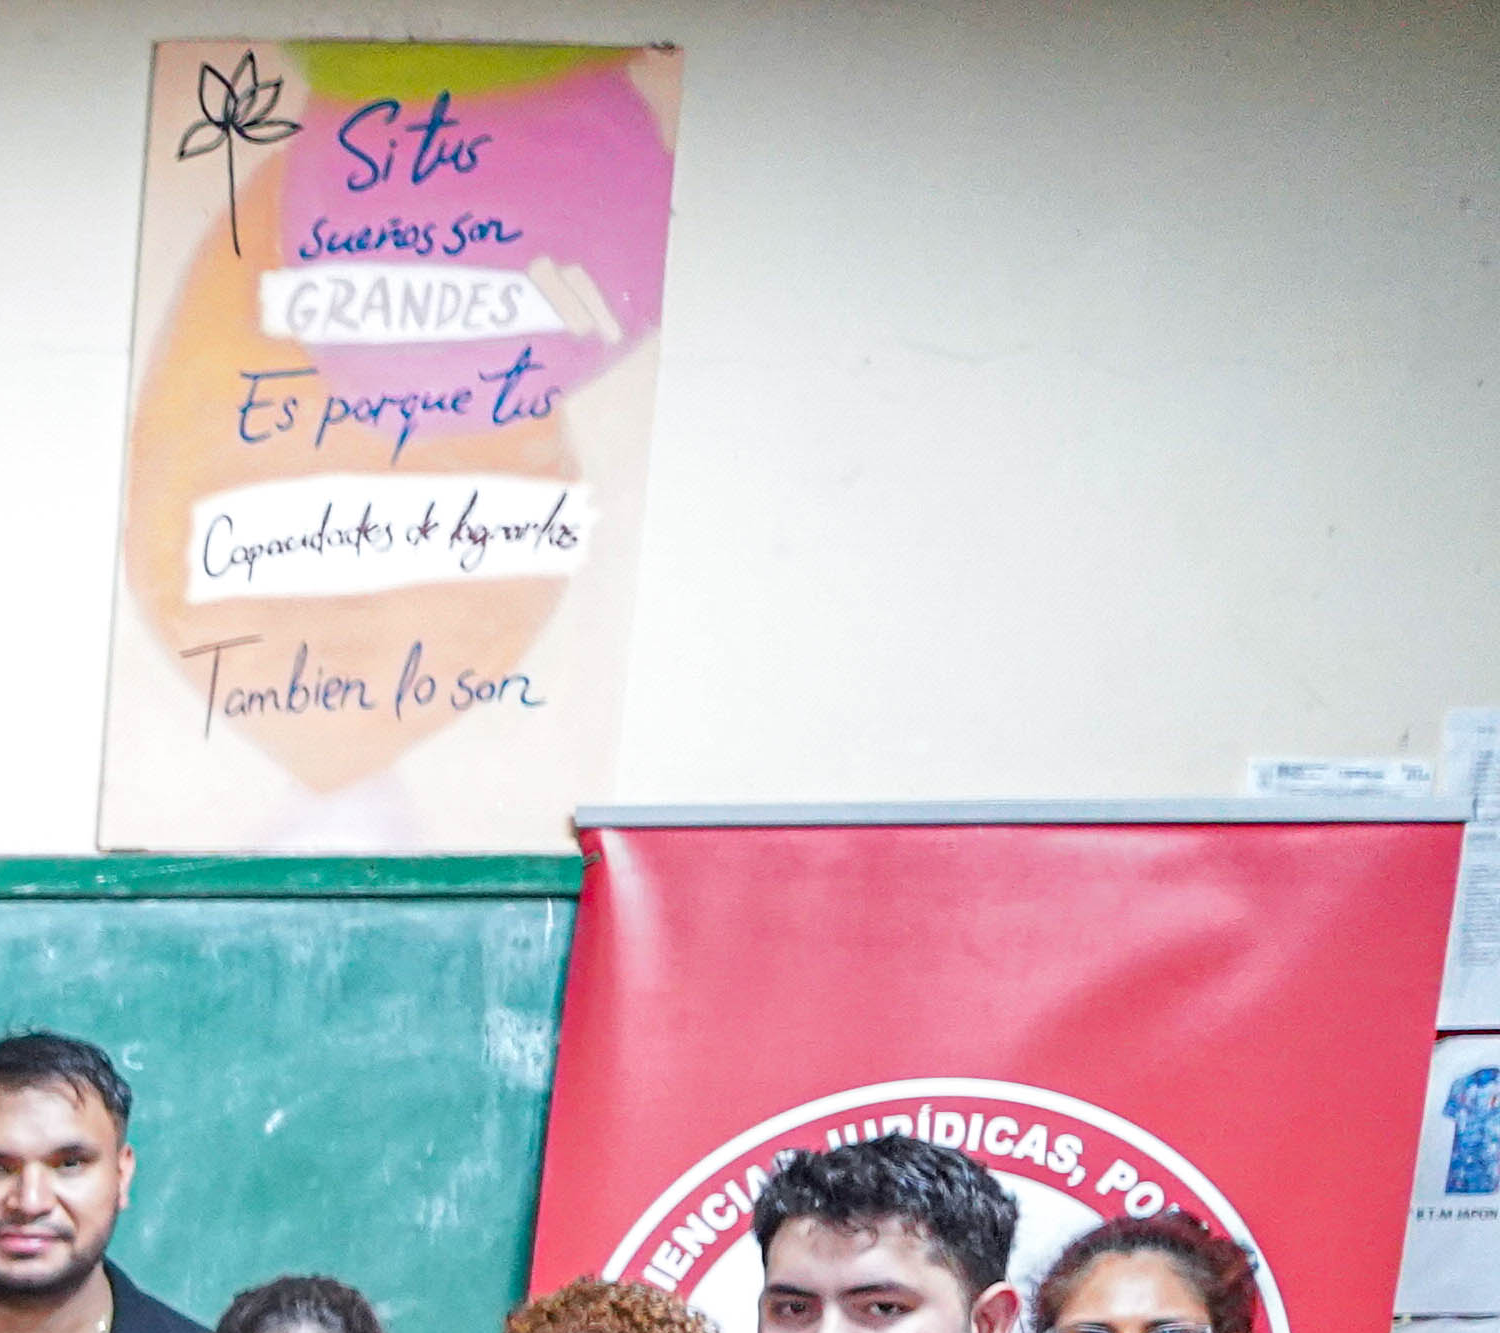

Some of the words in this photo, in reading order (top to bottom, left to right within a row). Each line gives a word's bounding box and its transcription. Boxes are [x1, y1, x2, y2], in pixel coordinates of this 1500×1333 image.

[337, 97, 402, 192] Si
[405, 88, 495, 186] tus
[443, 210, 524, 257] son
[285, 273, 524, 336] GRANDES
[237, 369, 319, 443] Es
[316, 388, 473, 463] porque
[478, 345, 563, 426] tus
[180, 635, 381, 739] Tambien
[394, 640, 435, 721] lo
[451, 672, 548, 711] son
[642, 1148, 798, 1293] IENCIA
